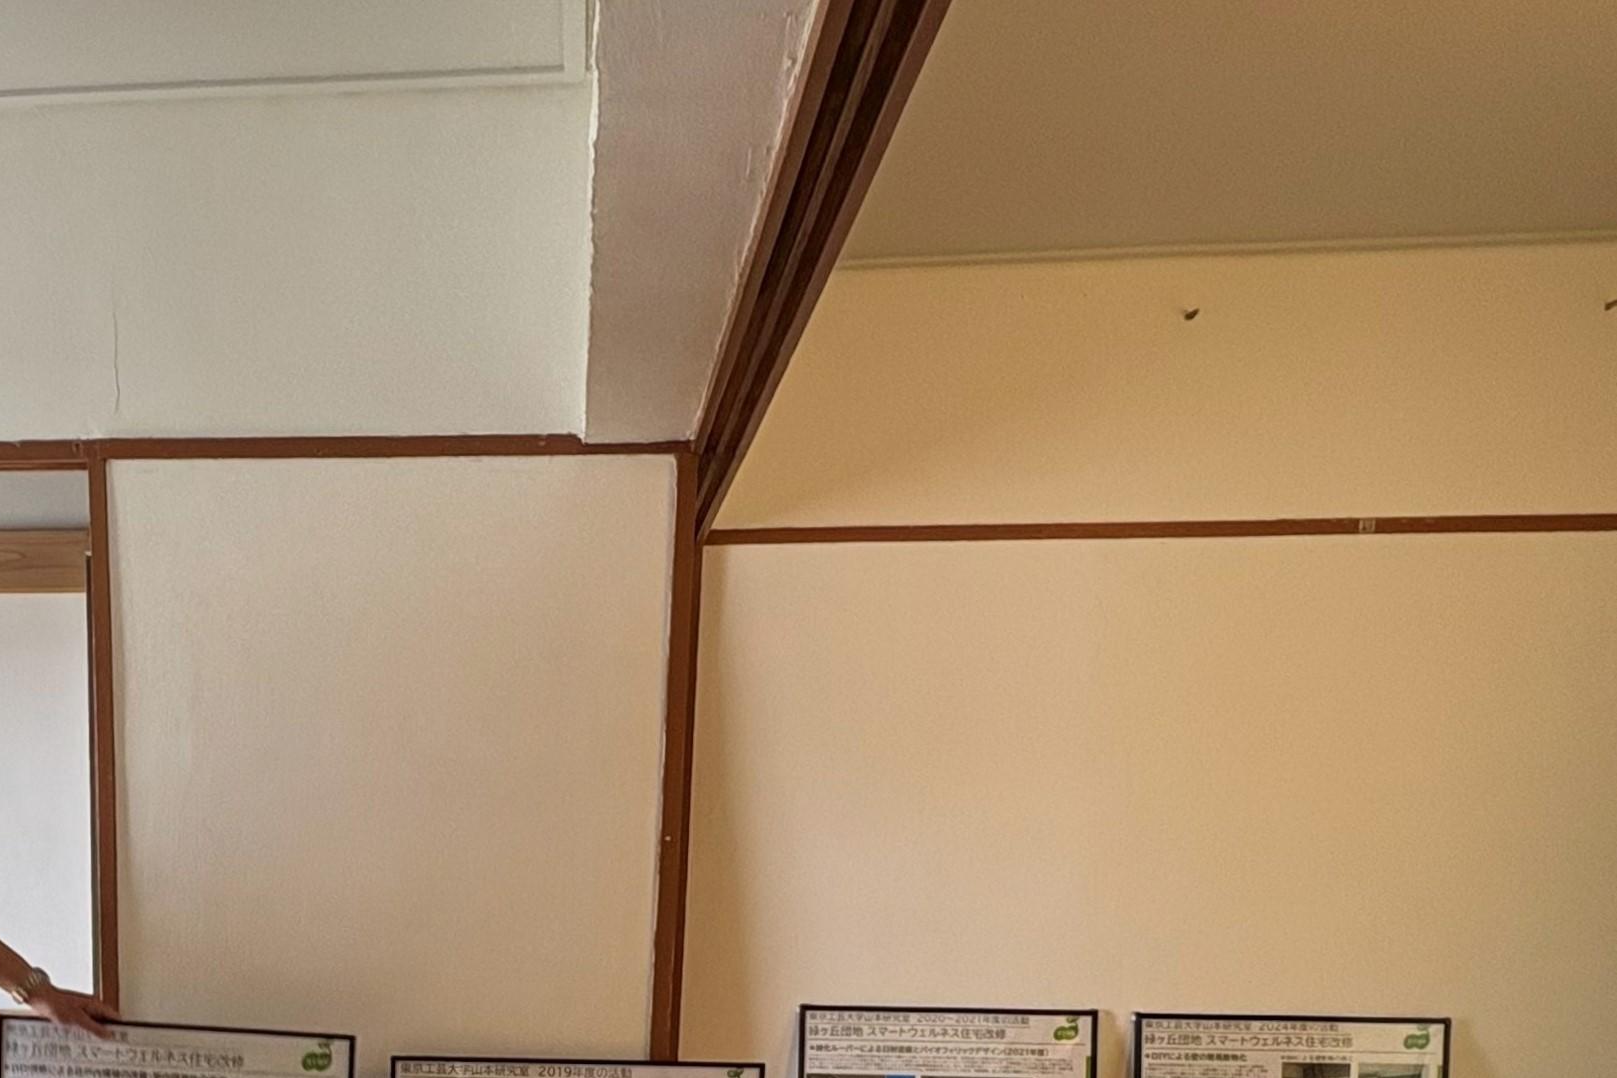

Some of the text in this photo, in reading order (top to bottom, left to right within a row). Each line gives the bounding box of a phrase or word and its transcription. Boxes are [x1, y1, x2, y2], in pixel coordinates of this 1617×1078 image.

[867, 1026, 1007, 1040] スマートウェルネス住宅改修
[1206, 1034, 1353, 1049] スマートウェルネス住宅改修
[400, 1063, 530, 1077] 東京工芸大学山本研究室
